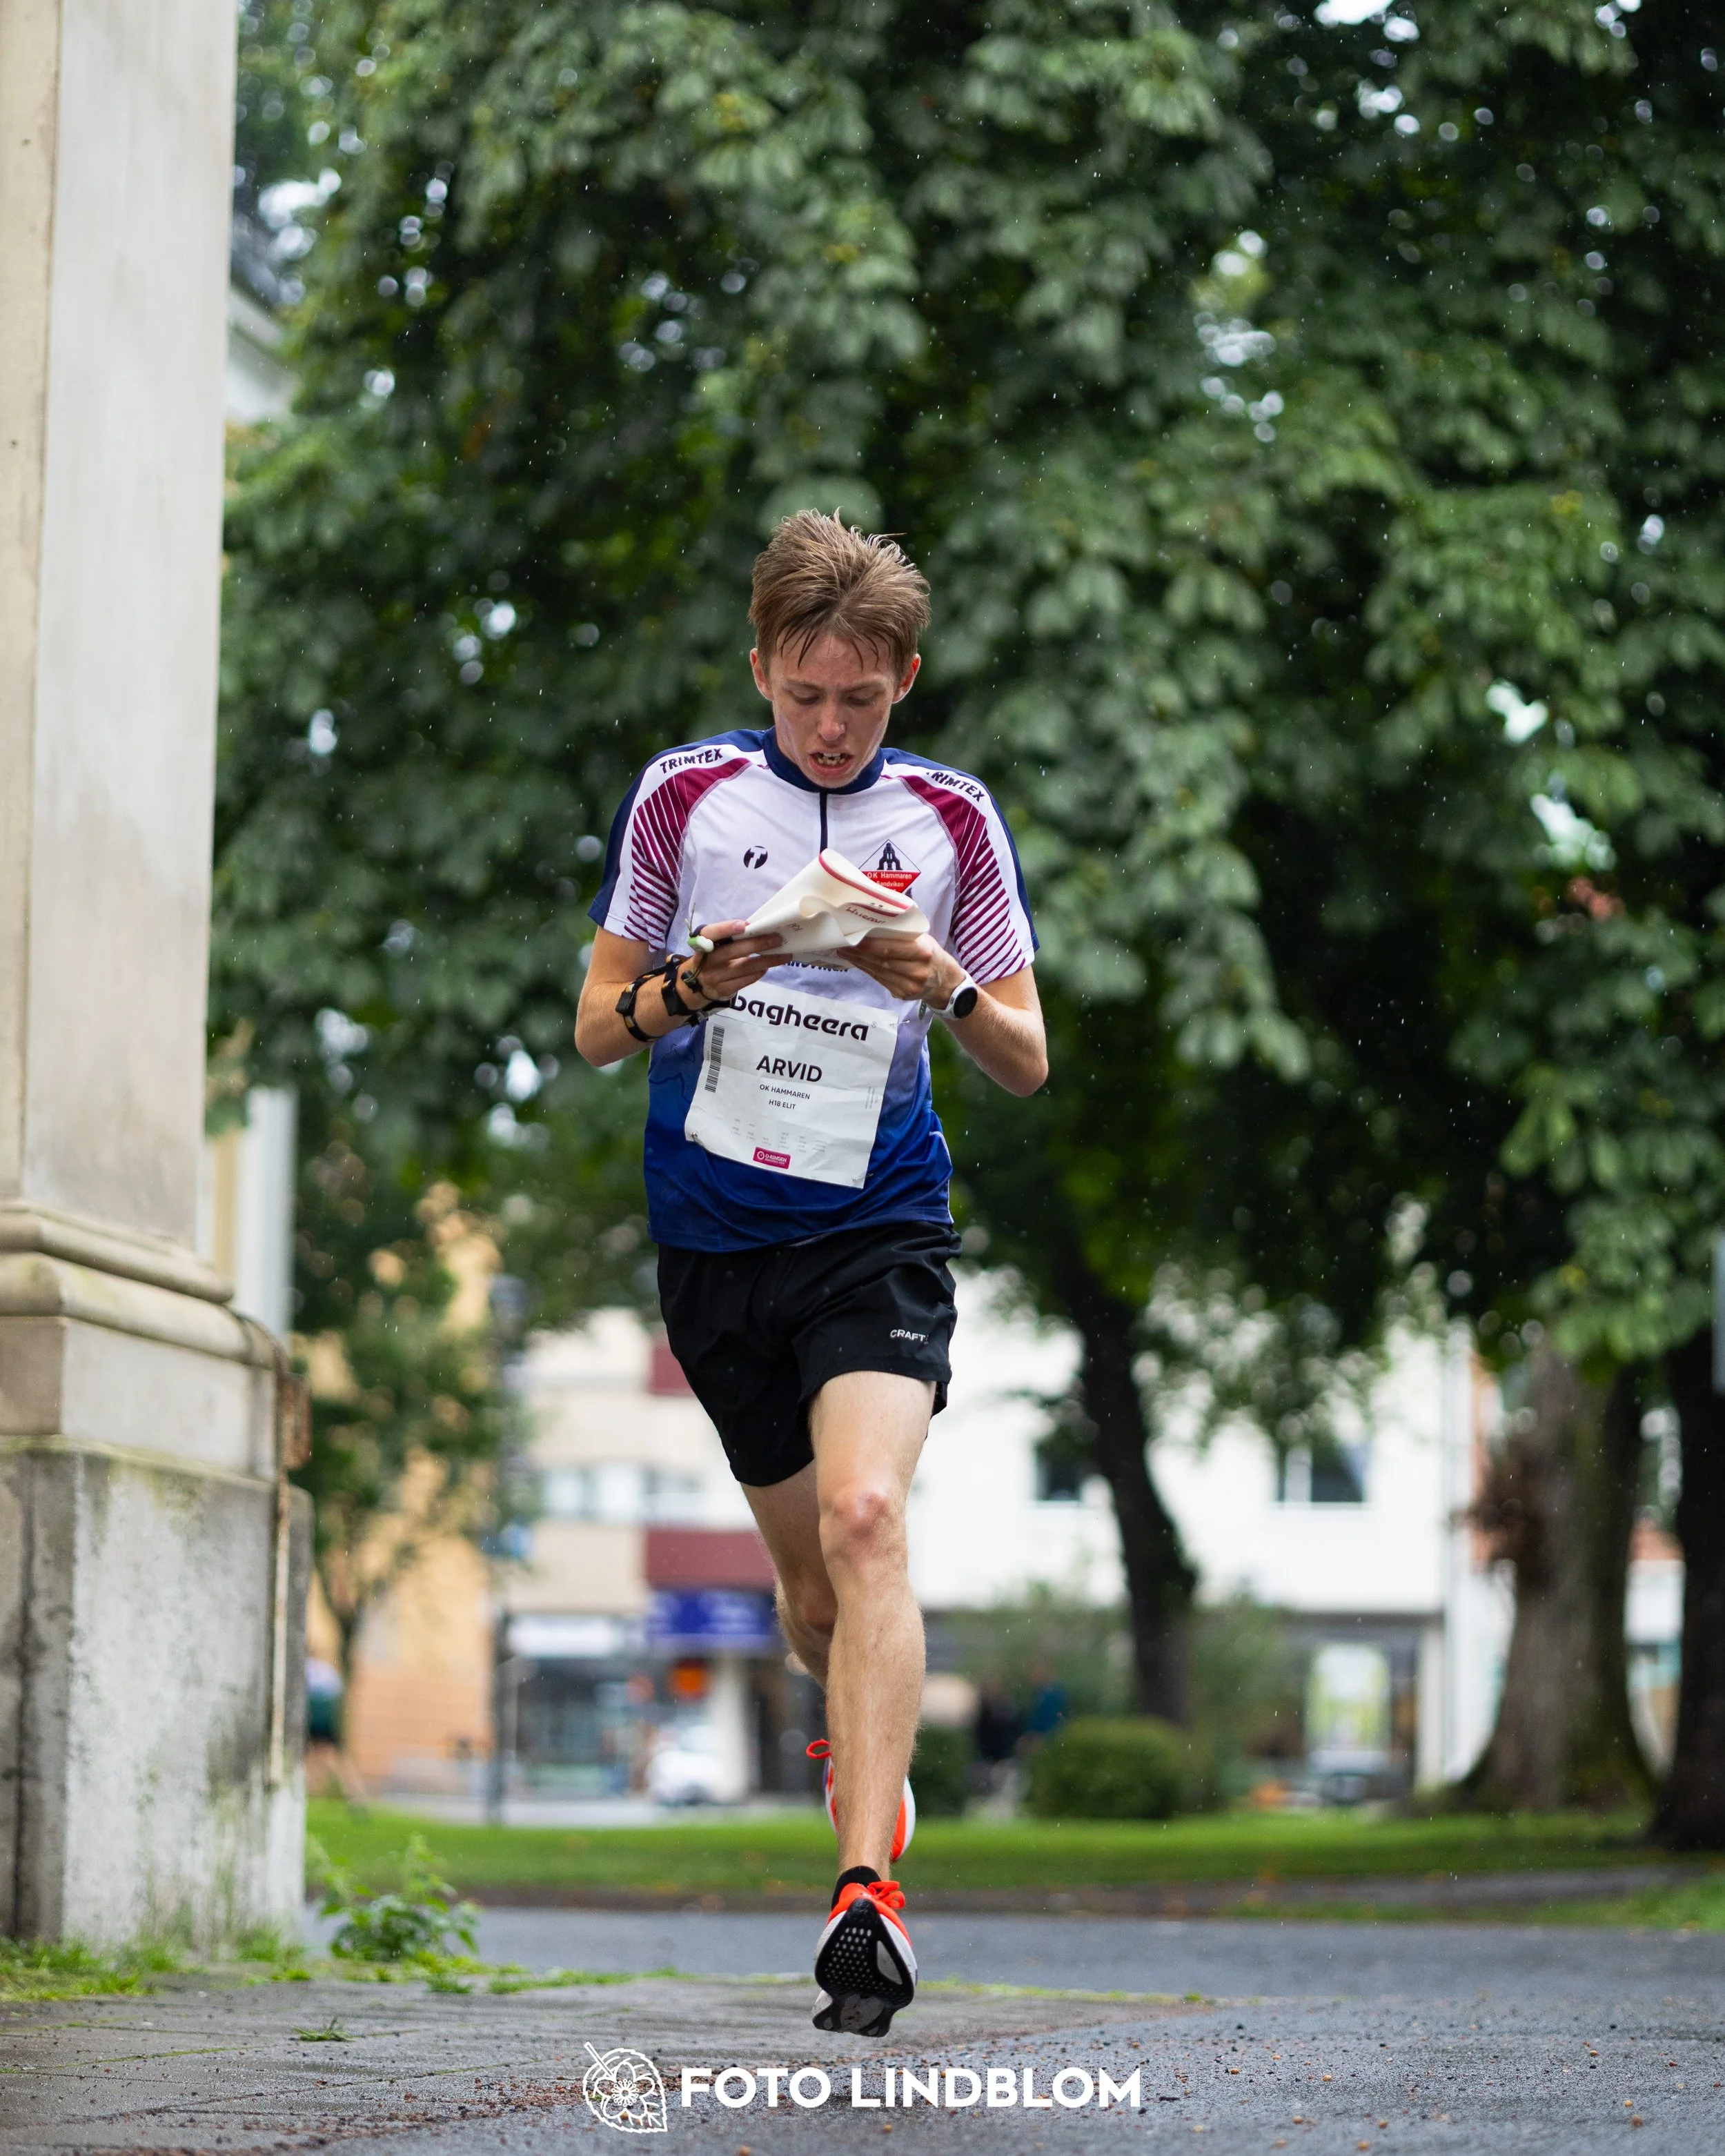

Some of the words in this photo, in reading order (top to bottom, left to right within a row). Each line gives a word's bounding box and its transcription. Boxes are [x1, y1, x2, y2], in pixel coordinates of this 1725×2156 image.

[660, 749, 722, 774] TRIMTEX
[926, 771, 985, 802] RIMTEX
[730, 994, 869, 1041] bagheera
[756, 1055, 822, 1082] ARVID
[769, 1099, 781, 1107] H18
[782, 1102, 796, 1110] ELIT
[771, 1086, 811, 1100] HAMMAREN
[890, 1329, 925, 1341] CRAFT
